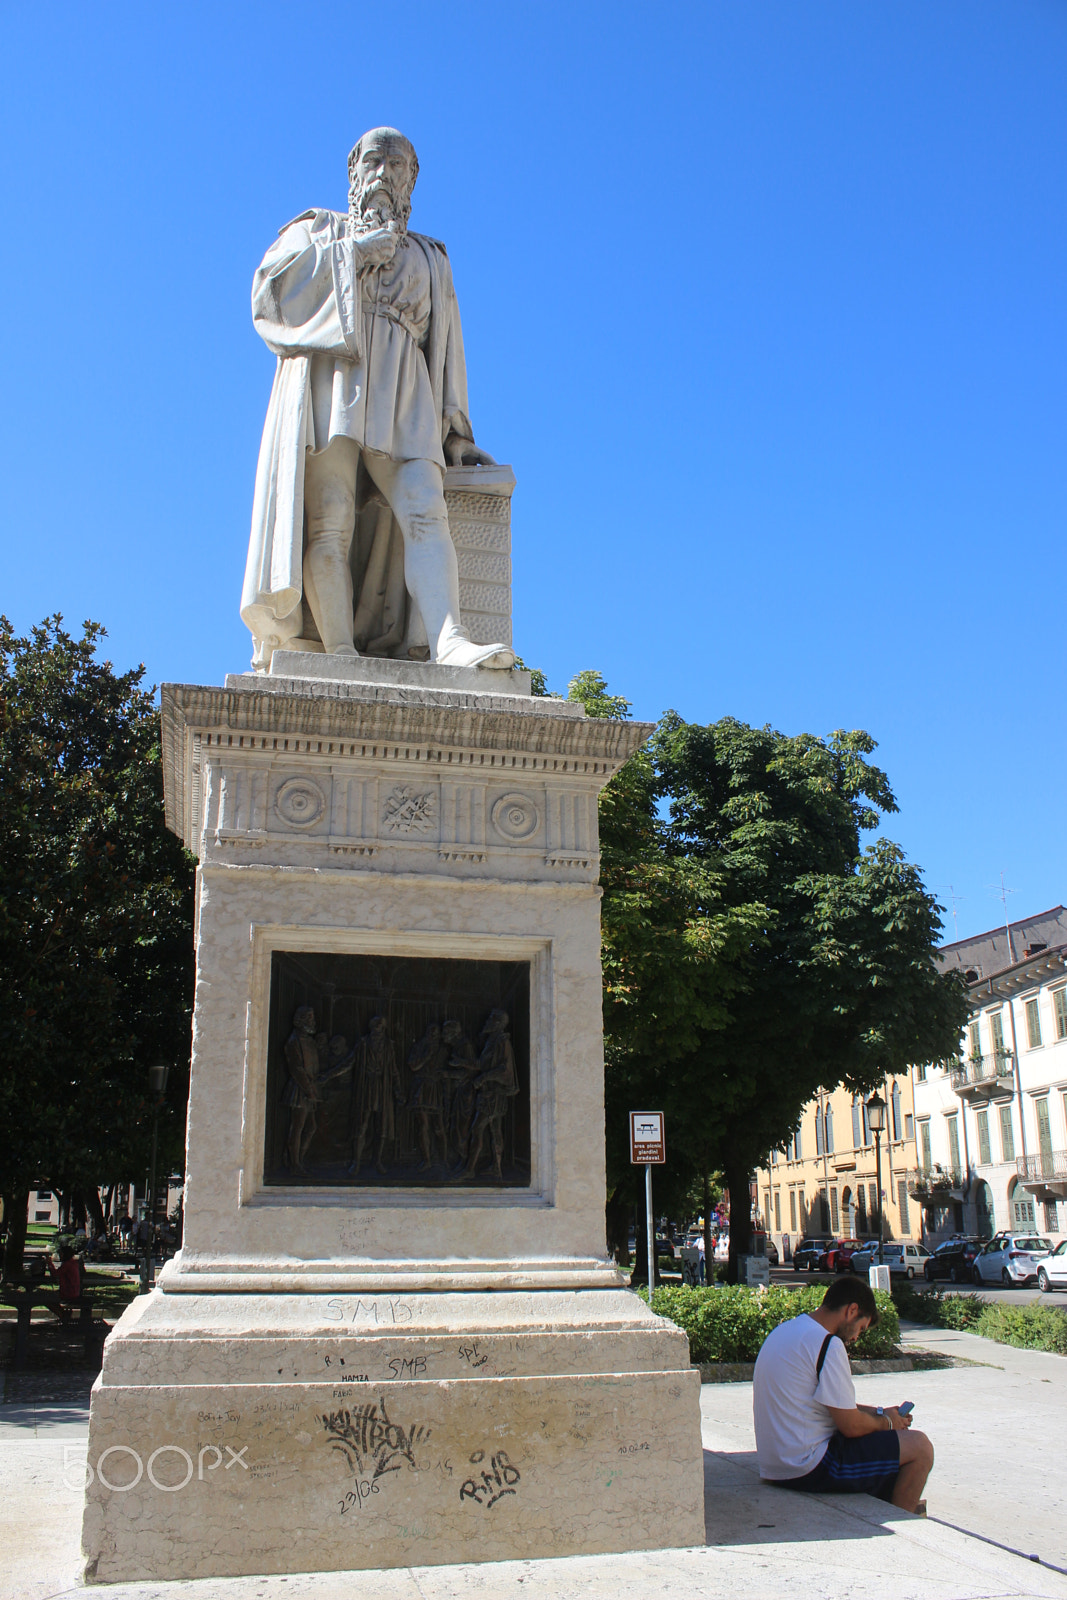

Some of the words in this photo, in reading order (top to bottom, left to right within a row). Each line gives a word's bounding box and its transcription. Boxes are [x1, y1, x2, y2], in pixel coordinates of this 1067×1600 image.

[341, 1374, 370, 1382] HAMZA
[386, 1355, 428, 1379] SMB
[337, 1479, 380, 1514] 23/06
